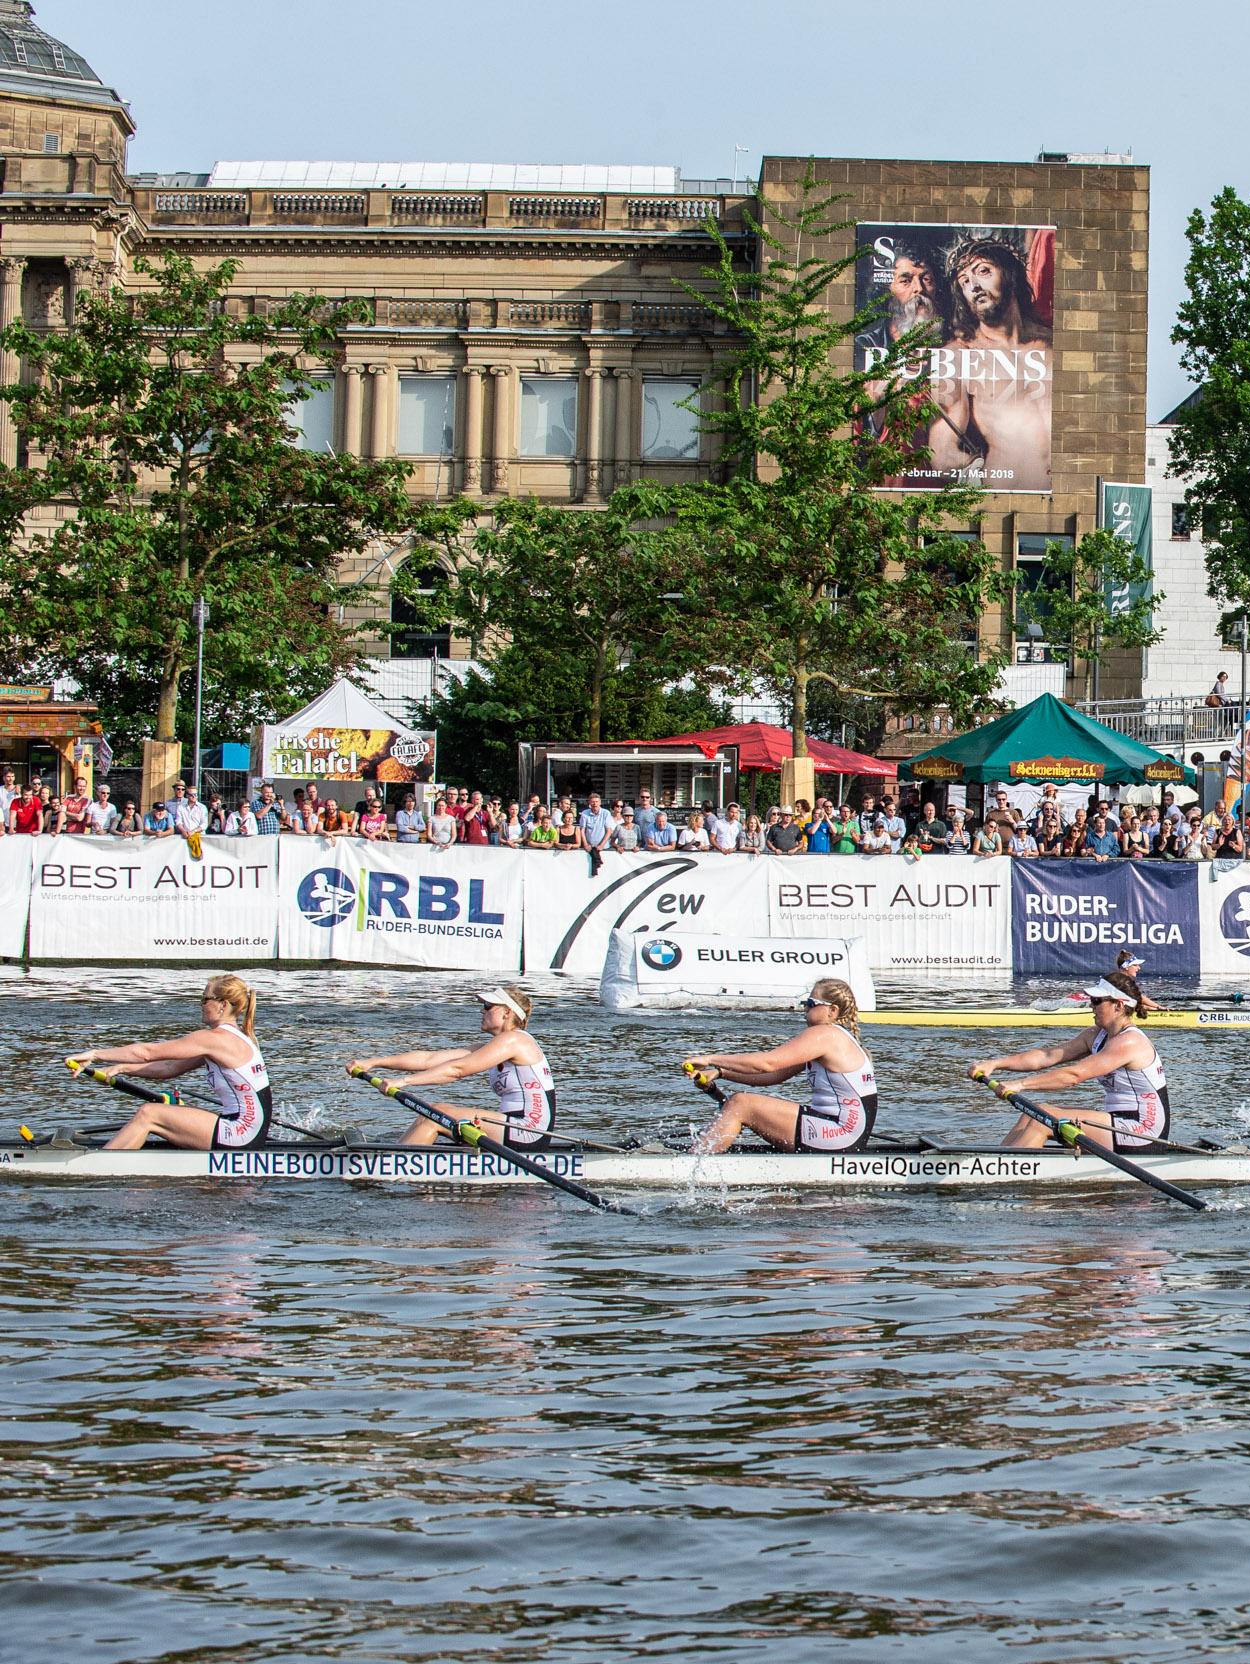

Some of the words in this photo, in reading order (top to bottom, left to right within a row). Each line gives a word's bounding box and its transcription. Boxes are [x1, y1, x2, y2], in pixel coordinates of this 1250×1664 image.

[873, 236, 895, 269] S
[968, 469, 987, 479] Mai
[990, 469, 1014, 479] 2018
[1111, 502, 1132, 617] RUNS
[275, 732, 341, 751] frische
[391, 743, 427, 756] FALAFEL
[275, 751, 359, 775] Falafel
[41, 864, 142, 889] BEST
[153, 864, 268, 889] AUDIT
[367, 871, 505, 926] RBL
[778, 884, 877, 908] BEST
[889, 883, 1002, 908] AUDIT
[1025, 893, 1118, 917] RUDER-
[366, 919, 504, 940] RUDER-BUNDESLIGA
[1025, 920, 1185, 945] BUNDESLIGA
[153, 936, 269, 947] www.bestaudit.de
[697, 949, 765, 963] EULER
[770, 950, 845, 966] GROUP
[890, 954, 1003, 965] www.bestaudit.de
[1210, 1013, 1231, 1021] RBL
[831, 1156, 1040, 1177] HavelQueen-Achter
